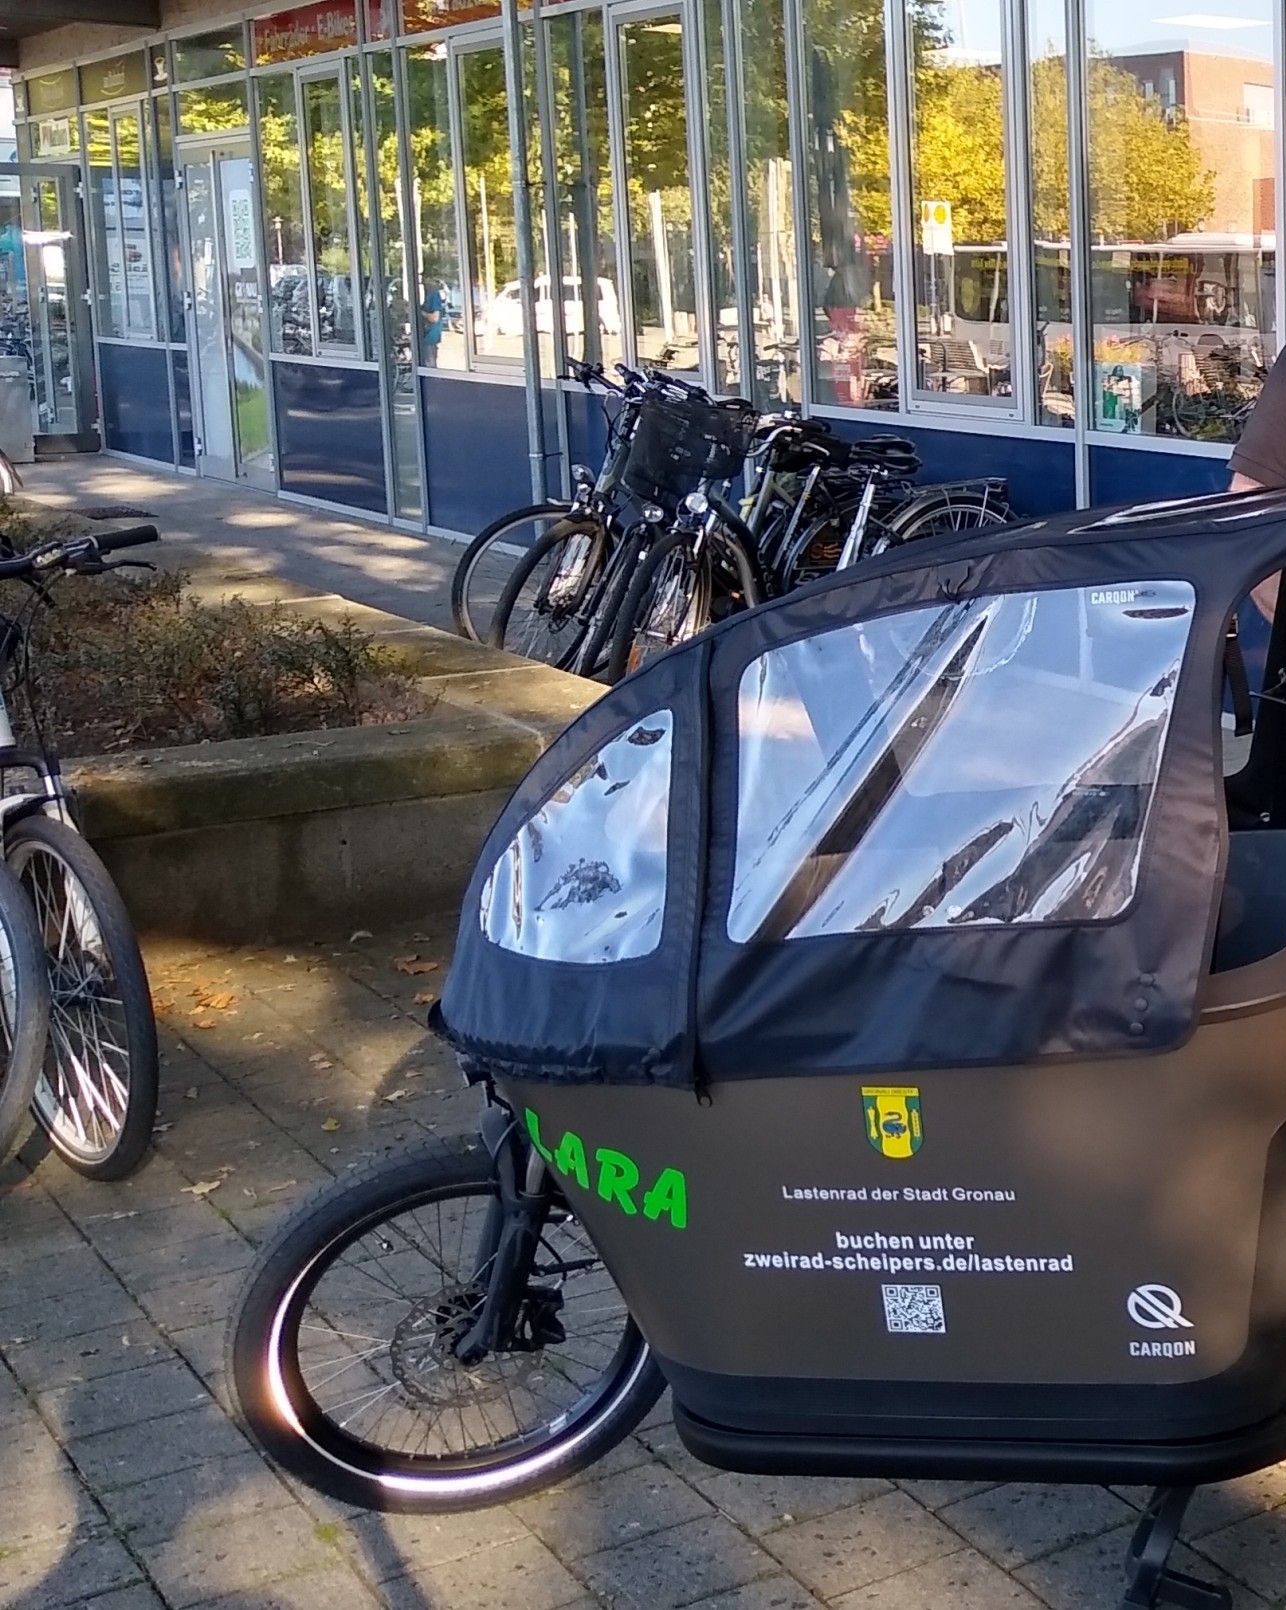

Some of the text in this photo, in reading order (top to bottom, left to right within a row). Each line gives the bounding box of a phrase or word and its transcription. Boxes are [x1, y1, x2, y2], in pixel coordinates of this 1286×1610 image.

[1091, 590, 1135, 605] CARQON
[525, 1107, 688, 1229] LARA
[782, 1185, 1016, 1202] Lastenrad der Stadt Gronau
[836, 1231, 975, 1250] buchen unter
[744, 1251, 1074, 1275] zweirad-scheipers.de/lastenrad
[1130, 1340, 1196, 1358] CARQON
